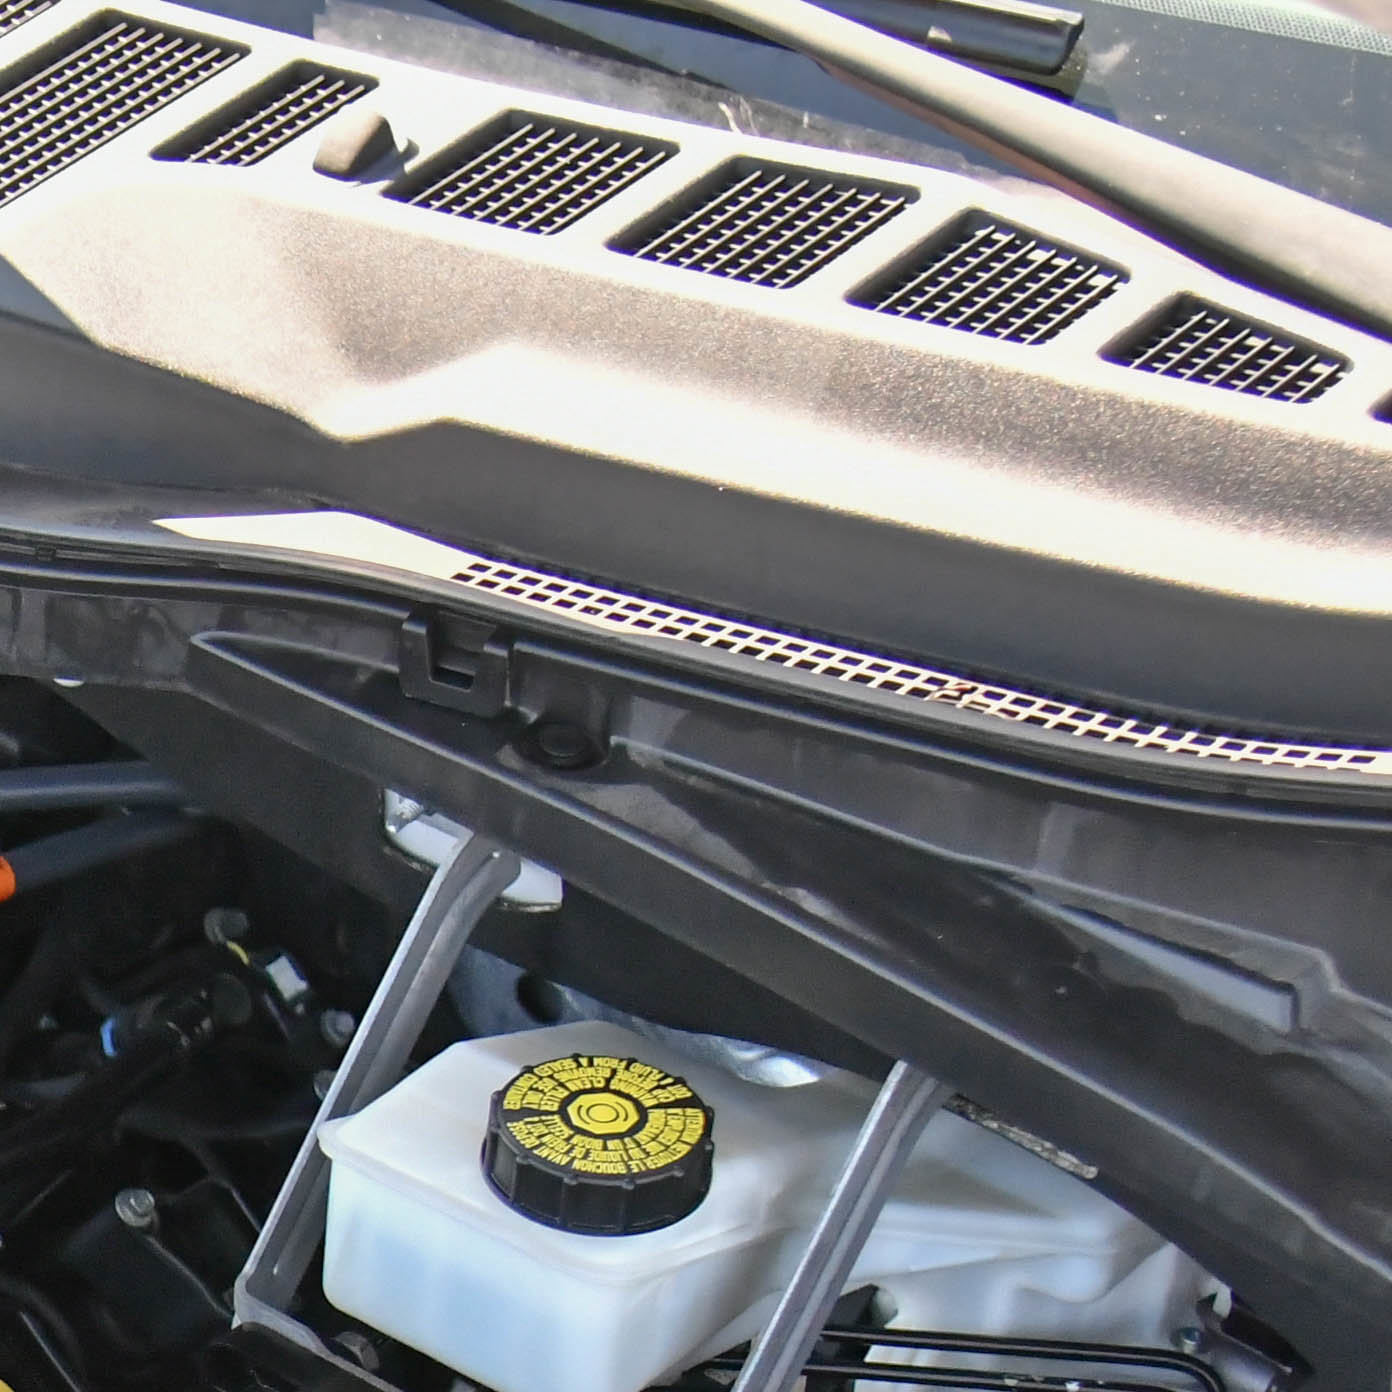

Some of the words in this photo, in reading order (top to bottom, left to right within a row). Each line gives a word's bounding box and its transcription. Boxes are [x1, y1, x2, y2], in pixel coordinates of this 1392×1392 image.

[533, 1058, 578, 1077] SEALED
[578, 1057, 589, 1067] A
[593, 1057, 627, 1069] FROM
[553, 1066, 611, 1083] REMOVING
[616, 1067, 659, 1090] BEFORE
[629, 1062, 665, 1080] FLUID
[503, 1073, 540, 1110] CONTAINER
[532, 1077, 558, 1093] USE
[564, 1077, 606, 1092] CLEAN
[609, 1076, 658, 1107] WARNING
[666, 1083, 693, 1100] DOT
[521, 1090, 545, 1109] ONLY
[538, 1086, 570, 1112] FILLER
[651, 1088, 676, 1103] CAP
[527, 1122, 550, 1137] DOT
[679, 1107, 706, 1145] ATTENTION
[540, 1133, 573, 1154] FREIN
[569, 1134, 604, 1150] BIDON
[532, 1145, 573, 1166] AVANT
[568, 1146, 587, 1159] DE
[586, 1149, 628, 1161] LIQUIDE
[627, 1147, 648, 1160] DU
[571, 1160, 628, 1174] BOUCHON
[627, 1159, 647, 1173] LE
